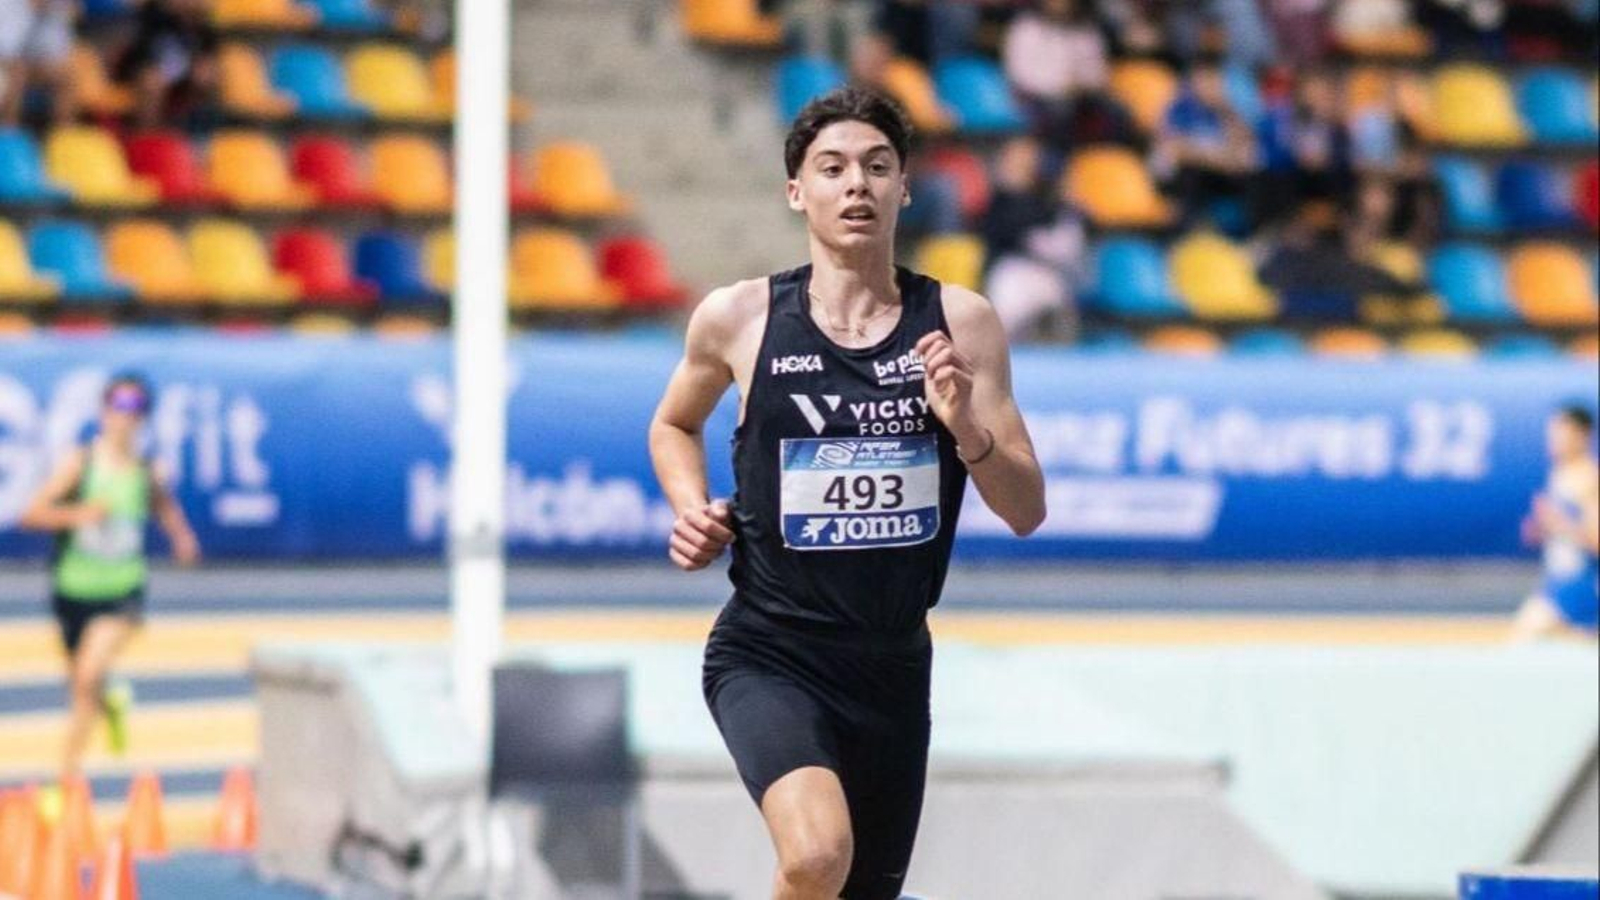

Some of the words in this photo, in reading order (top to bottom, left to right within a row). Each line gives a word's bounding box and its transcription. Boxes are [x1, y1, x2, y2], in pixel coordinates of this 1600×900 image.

[772, 355, 823, 375] HOKA
[873, 361, 896, 378] be
[849, 397, 928, 420] VICKY
[859, 418, 925, 435] FOODS
[823, 474, 904, 511] 493
